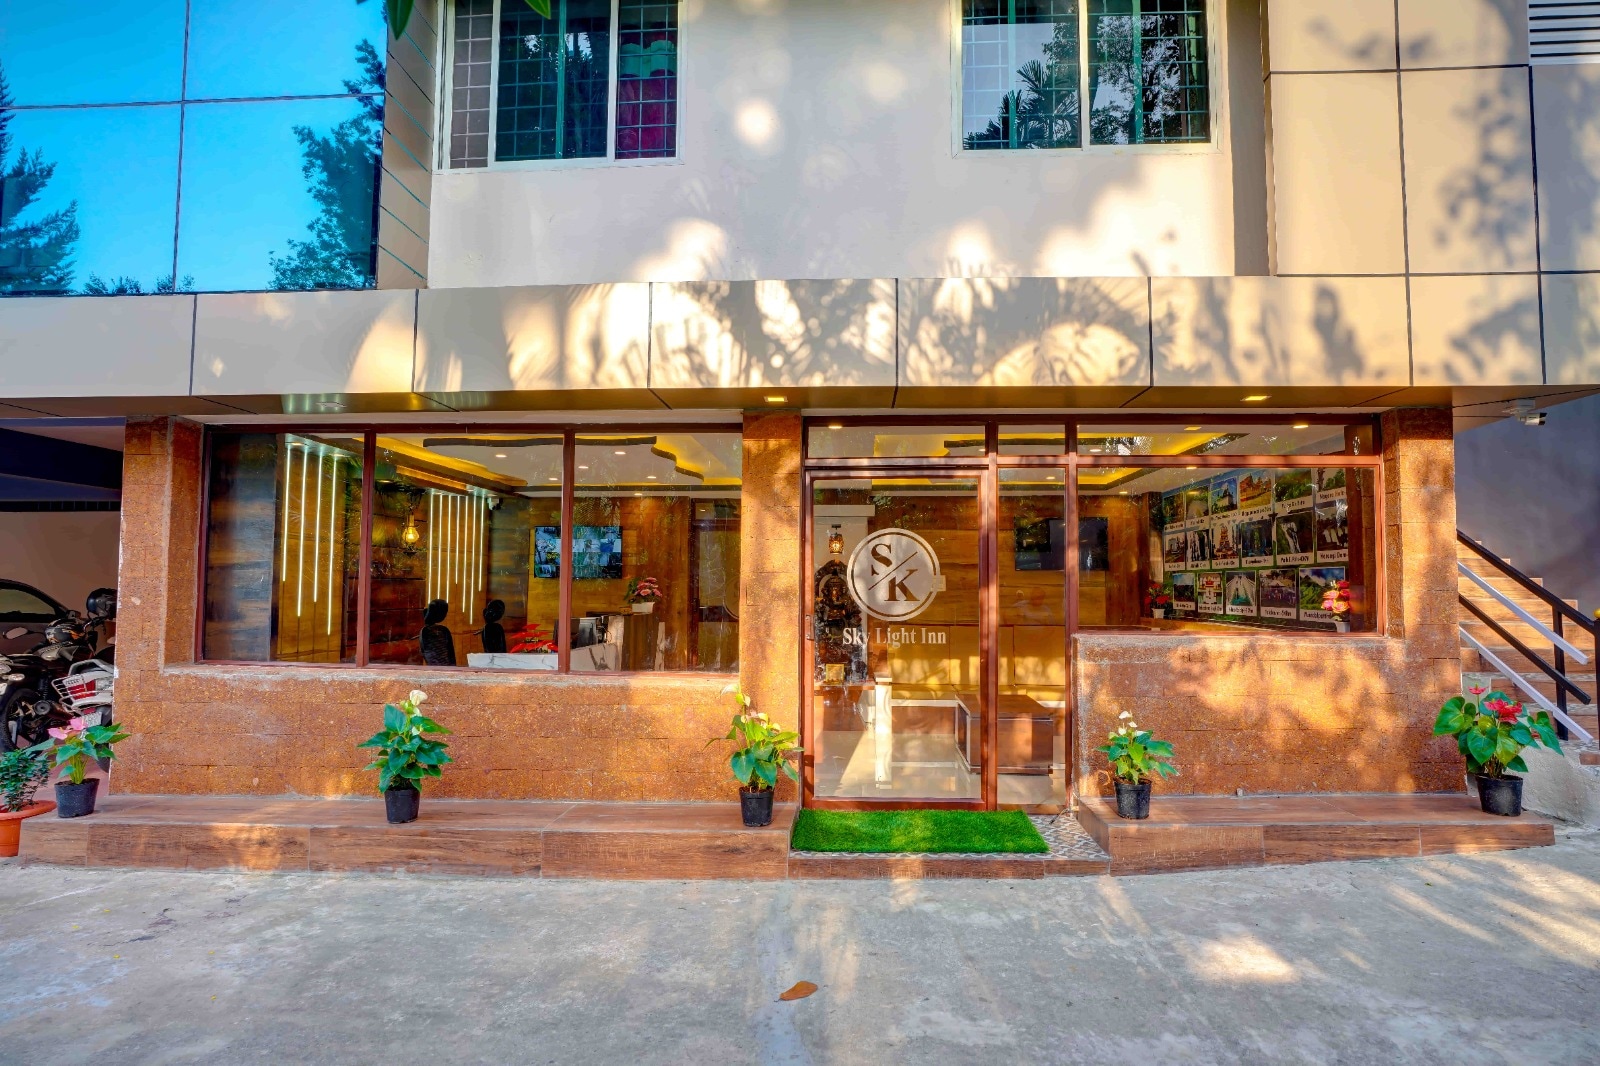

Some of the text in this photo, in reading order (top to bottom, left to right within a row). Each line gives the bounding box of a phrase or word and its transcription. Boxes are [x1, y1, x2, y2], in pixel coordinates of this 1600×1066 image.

[842, 627, 947, 648] Sky Light Inn
